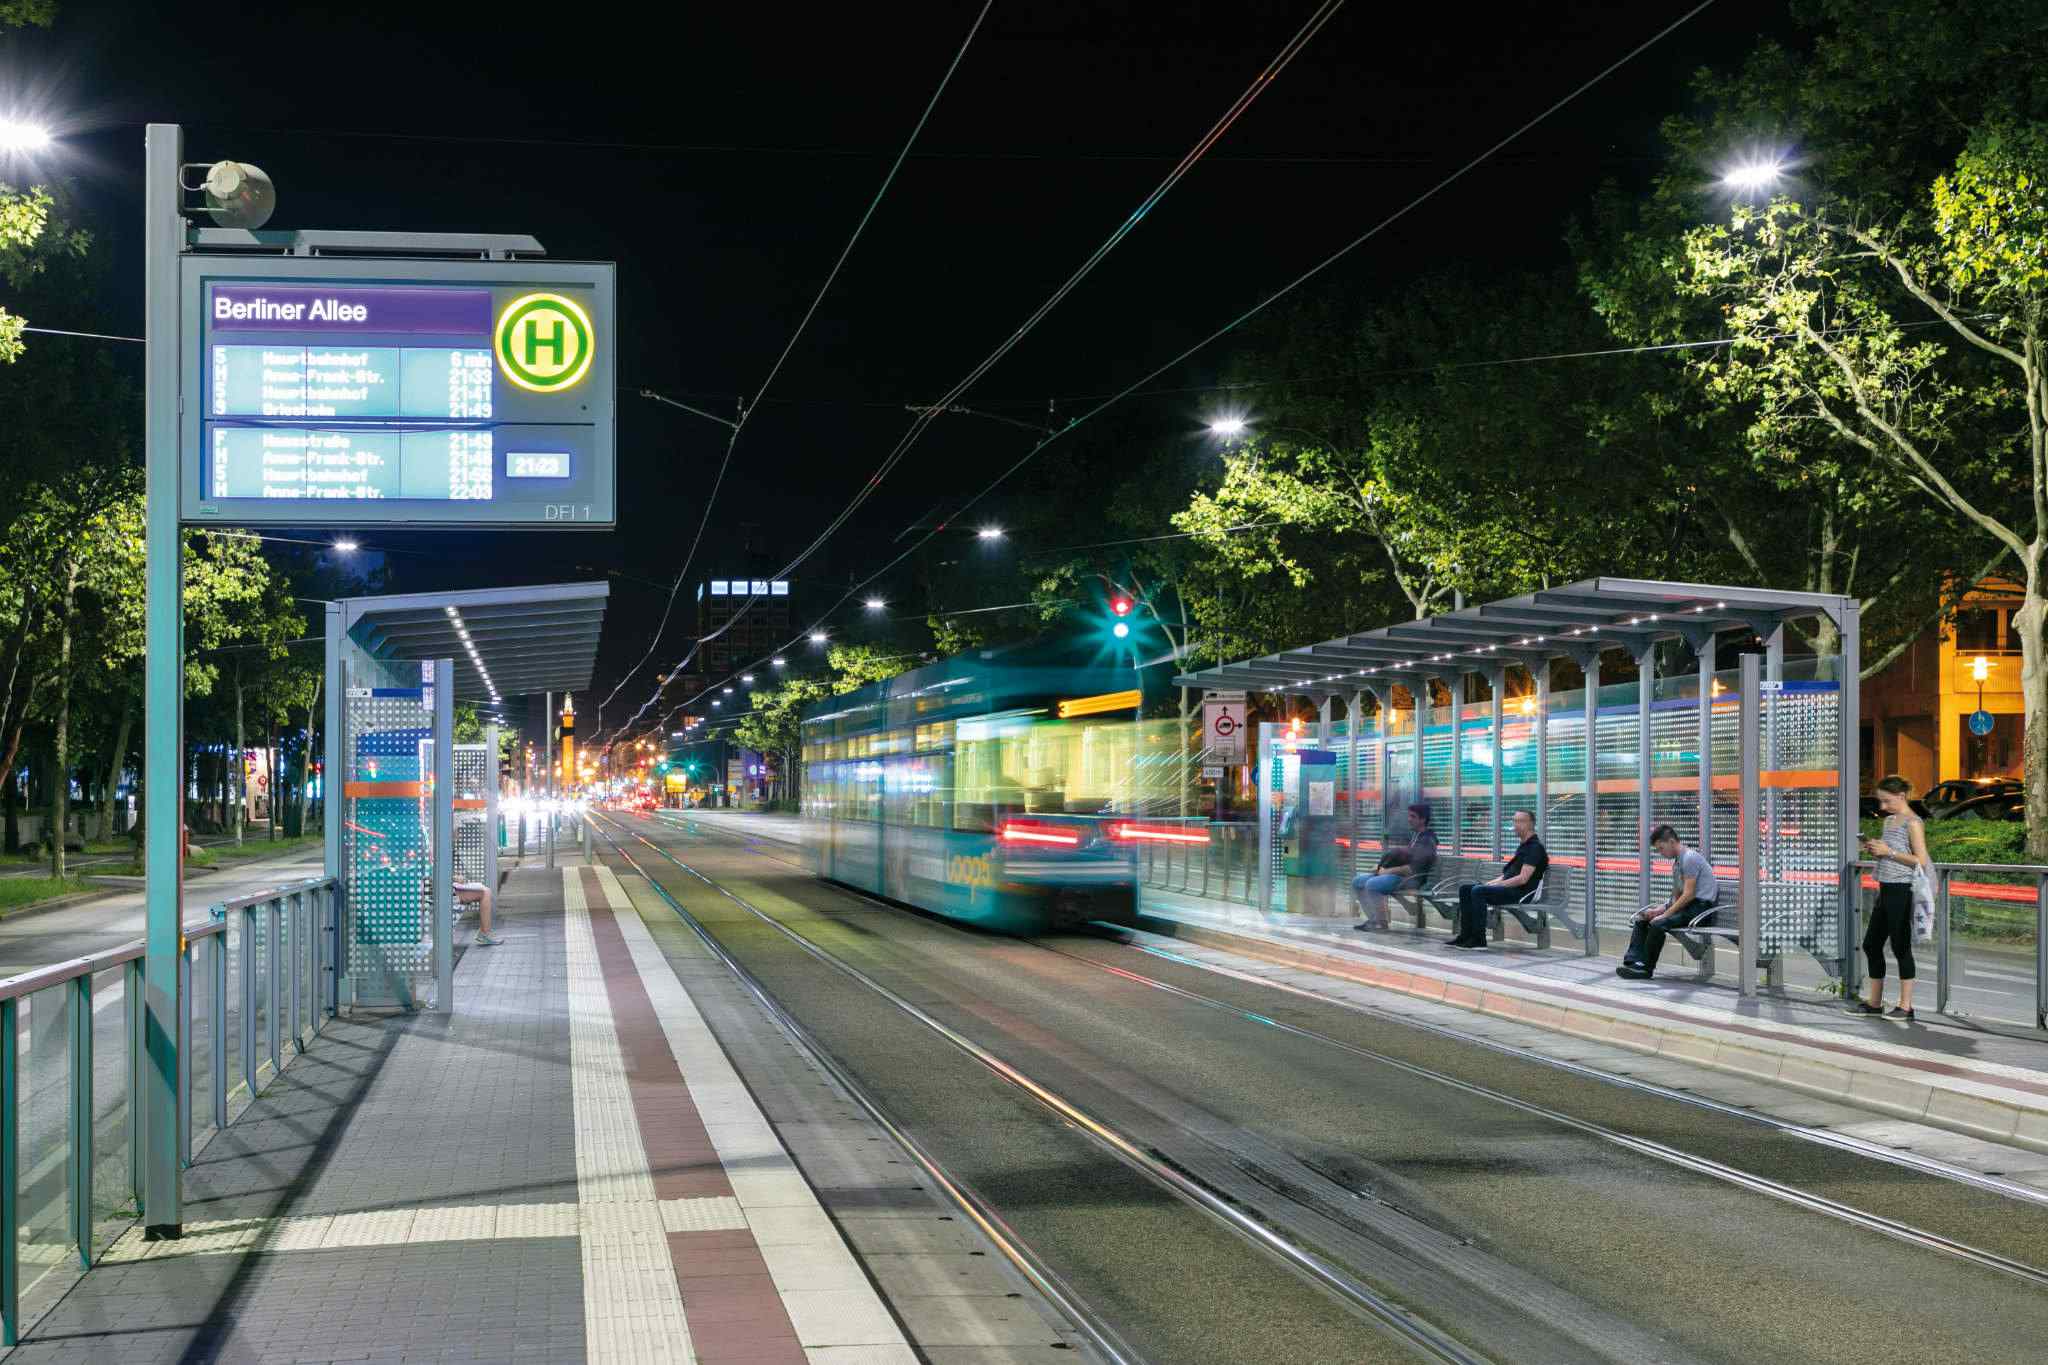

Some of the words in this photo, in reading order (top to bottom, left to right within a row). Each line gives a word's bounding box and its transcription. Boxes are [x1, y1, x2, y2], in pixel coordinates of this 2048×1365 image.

[215, 297, 305, 321] Berliner
[309, 298, 367, 322] Allee
[524, 319, 565, 366] H
[545, 504, 575, 520] DFI
[584, 504, 592, 520] 1
